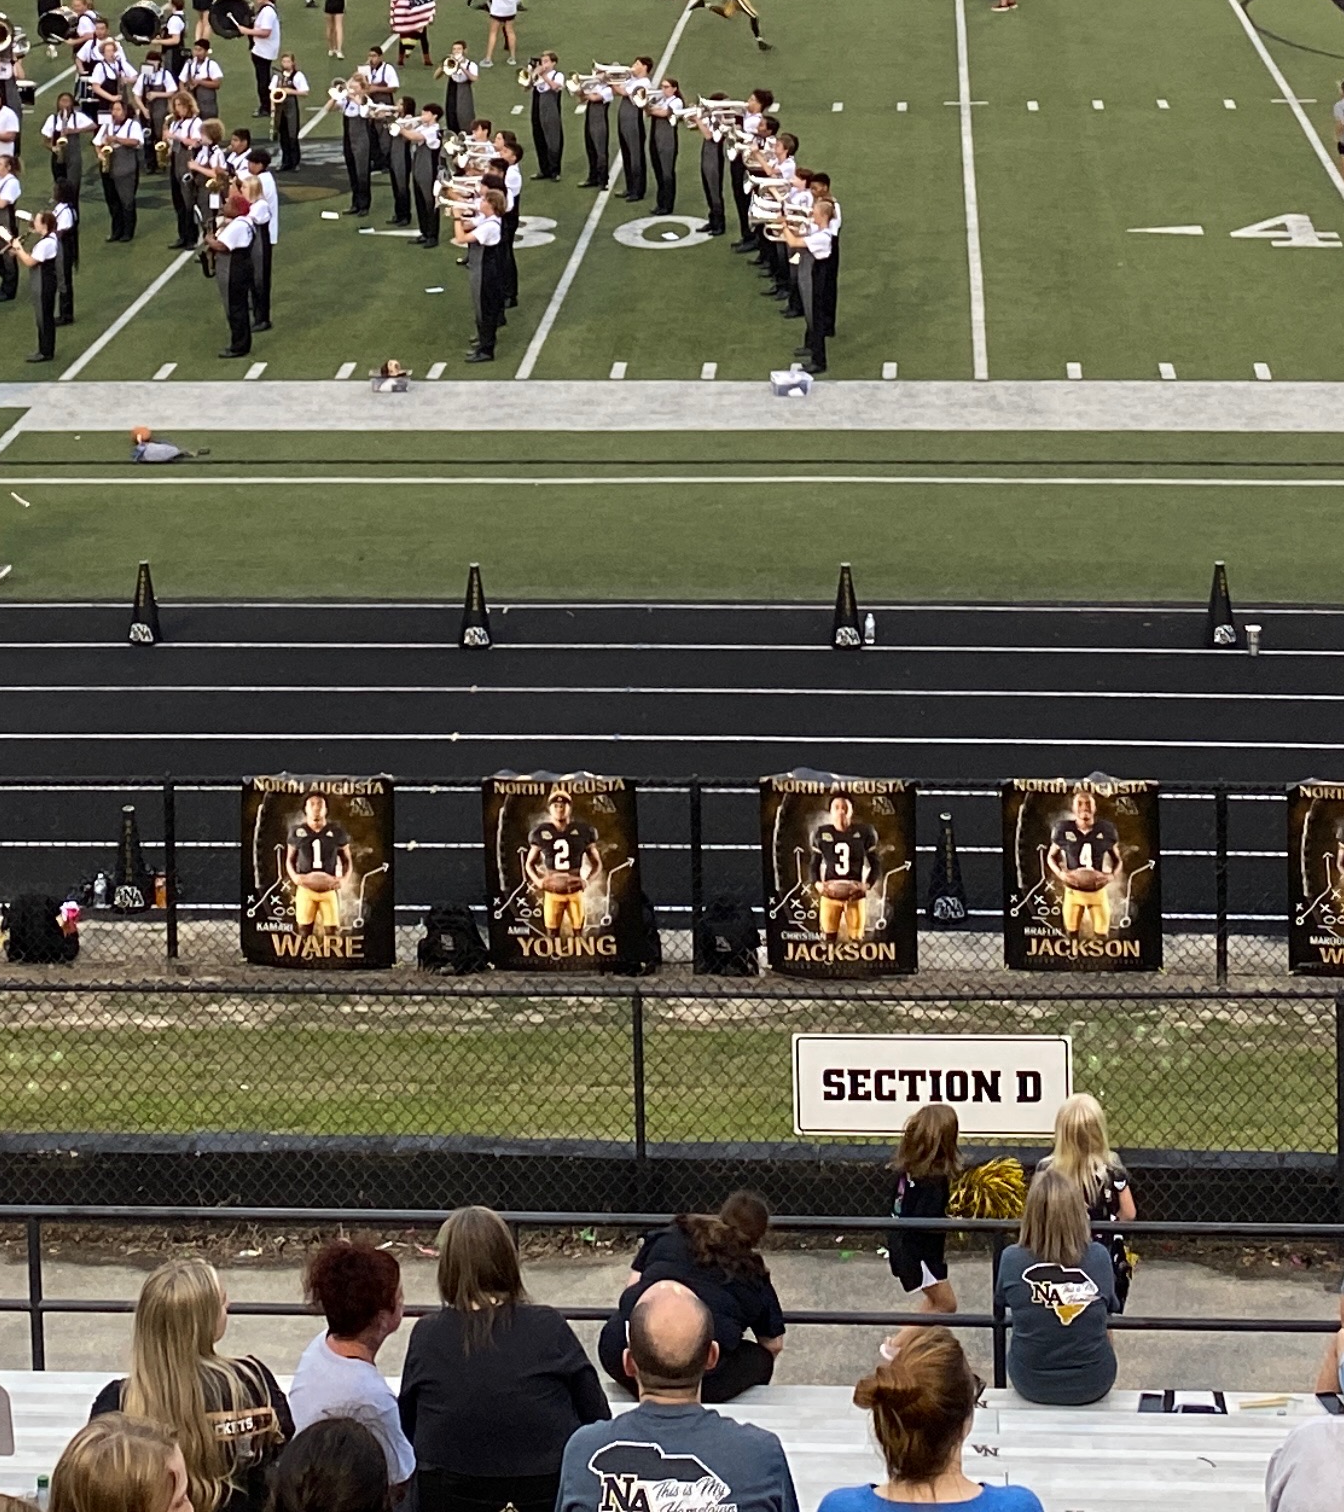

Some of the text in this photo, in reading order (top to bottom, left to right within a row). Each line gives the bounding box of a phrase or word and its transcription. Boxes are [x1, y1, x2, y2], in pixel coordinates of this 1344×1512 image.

[311, 838, 323, 869] 1
[554, 839, 570, 870] 2
[834, 842, 850, 876] 3
[1079, 842, 1093, 869] 4
[271, 934, 365, 959] WARE
[517, 935, 618, 958] YOUNG
[783, 942, 896, 962] JACKSON
[1026, 939, 1141, 959] JACKSON
[822, 1068, 1043, 1104] SECTION D
[1033, 1283, 1065, 1306] NA
[601, 1475, 652, 1512] NA
[653, 1477, 727, 1500] This is My
